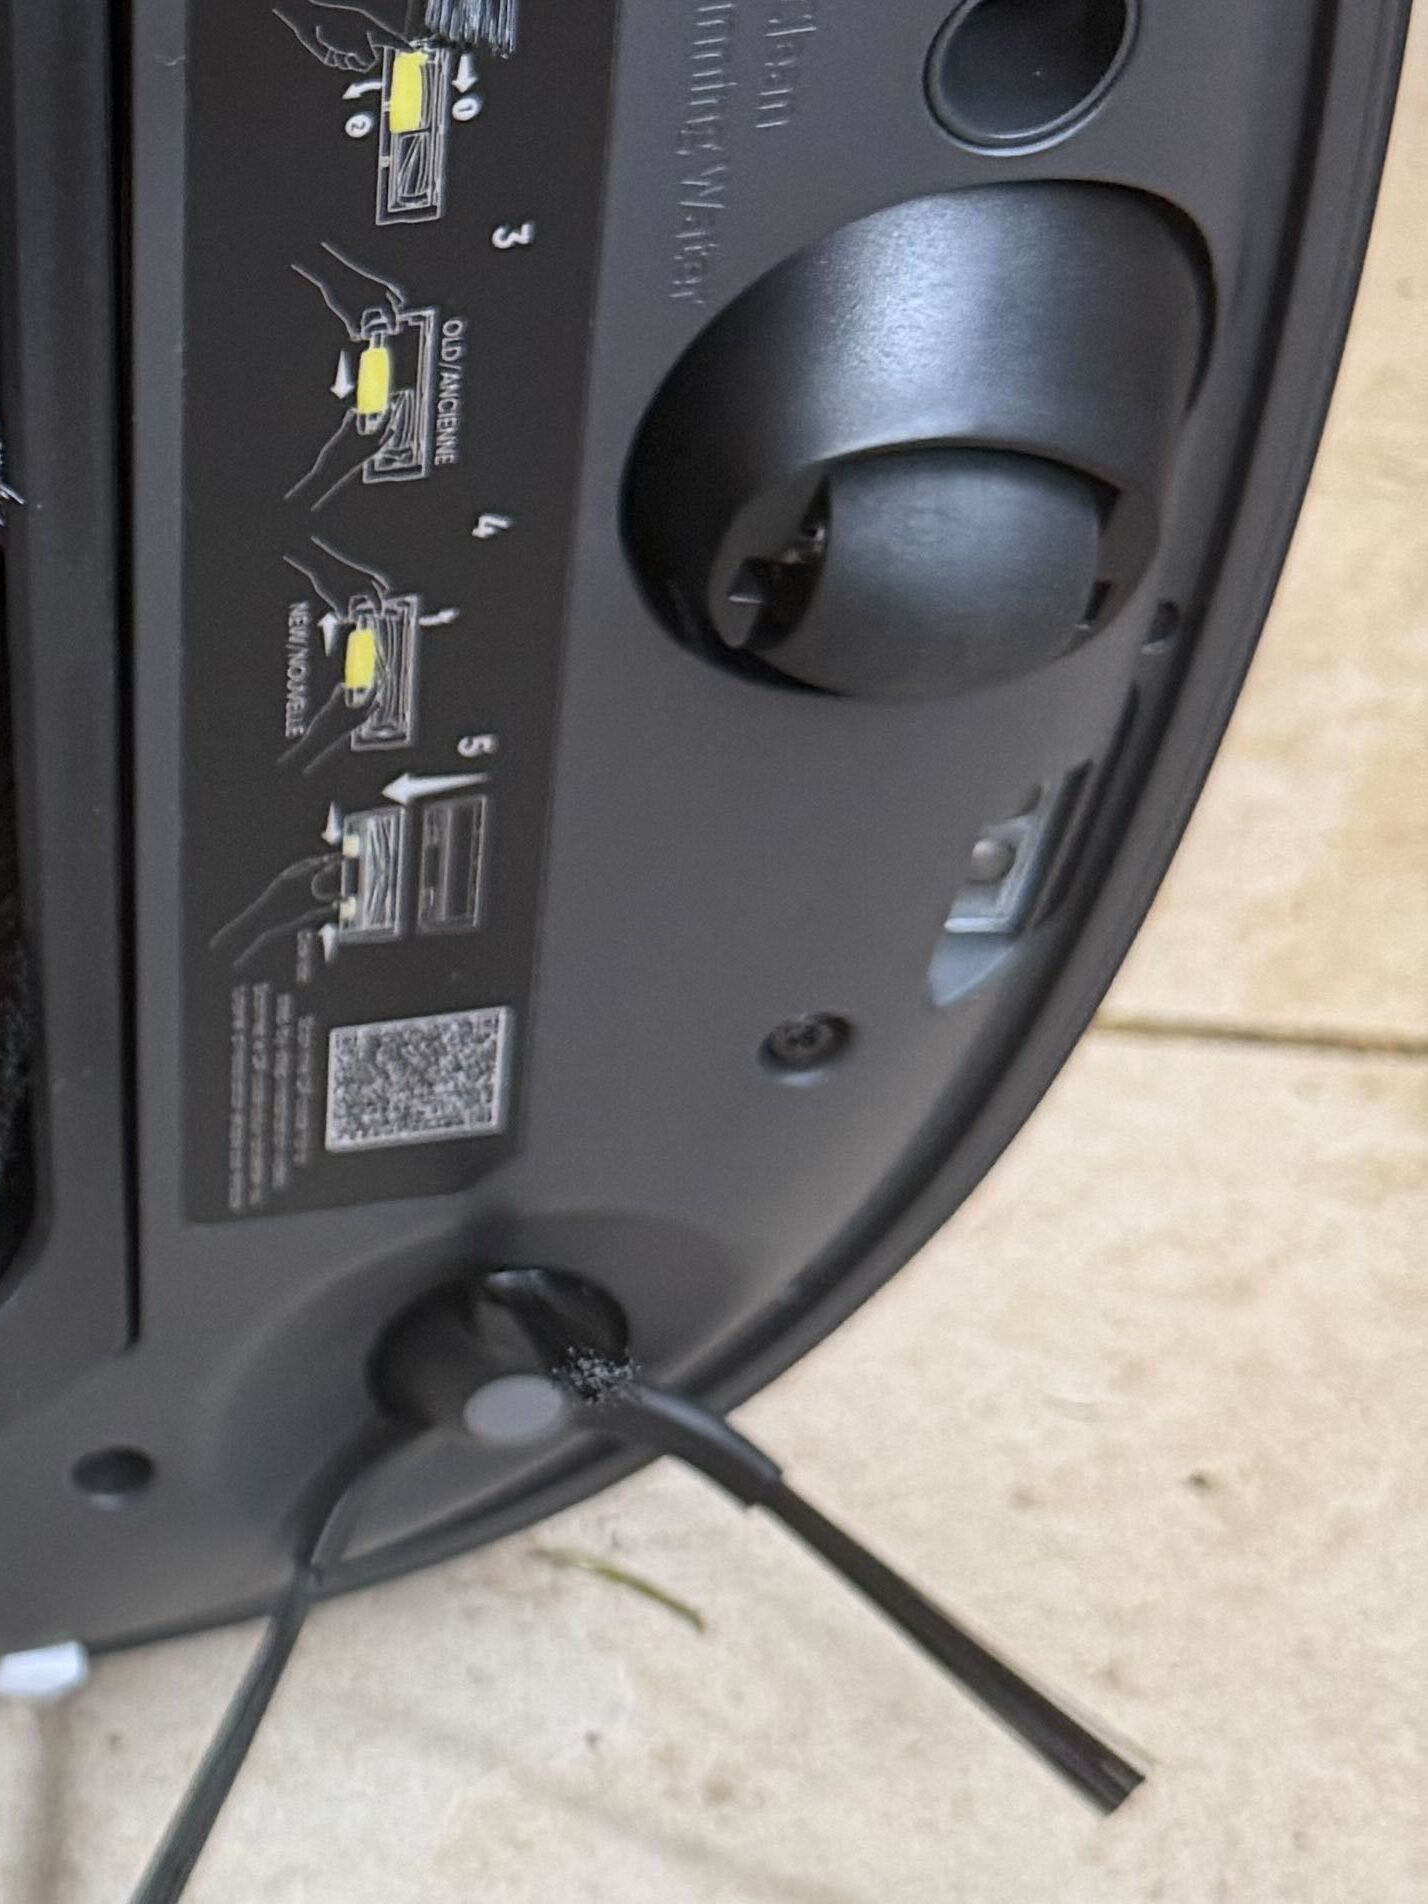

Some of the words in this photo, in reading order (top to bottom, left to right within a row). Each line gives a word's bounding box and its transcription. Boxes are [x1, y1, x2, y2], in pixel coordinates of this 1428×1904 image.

[489, 219, 537, 251] 3
[432, 316, 464, 468] OLD/ANCIENNE
[469, 508, 515, 541] 4
[283, 599, 310, 739] NEW/NOUVELLE
[455, 731, 499, 759] 5
